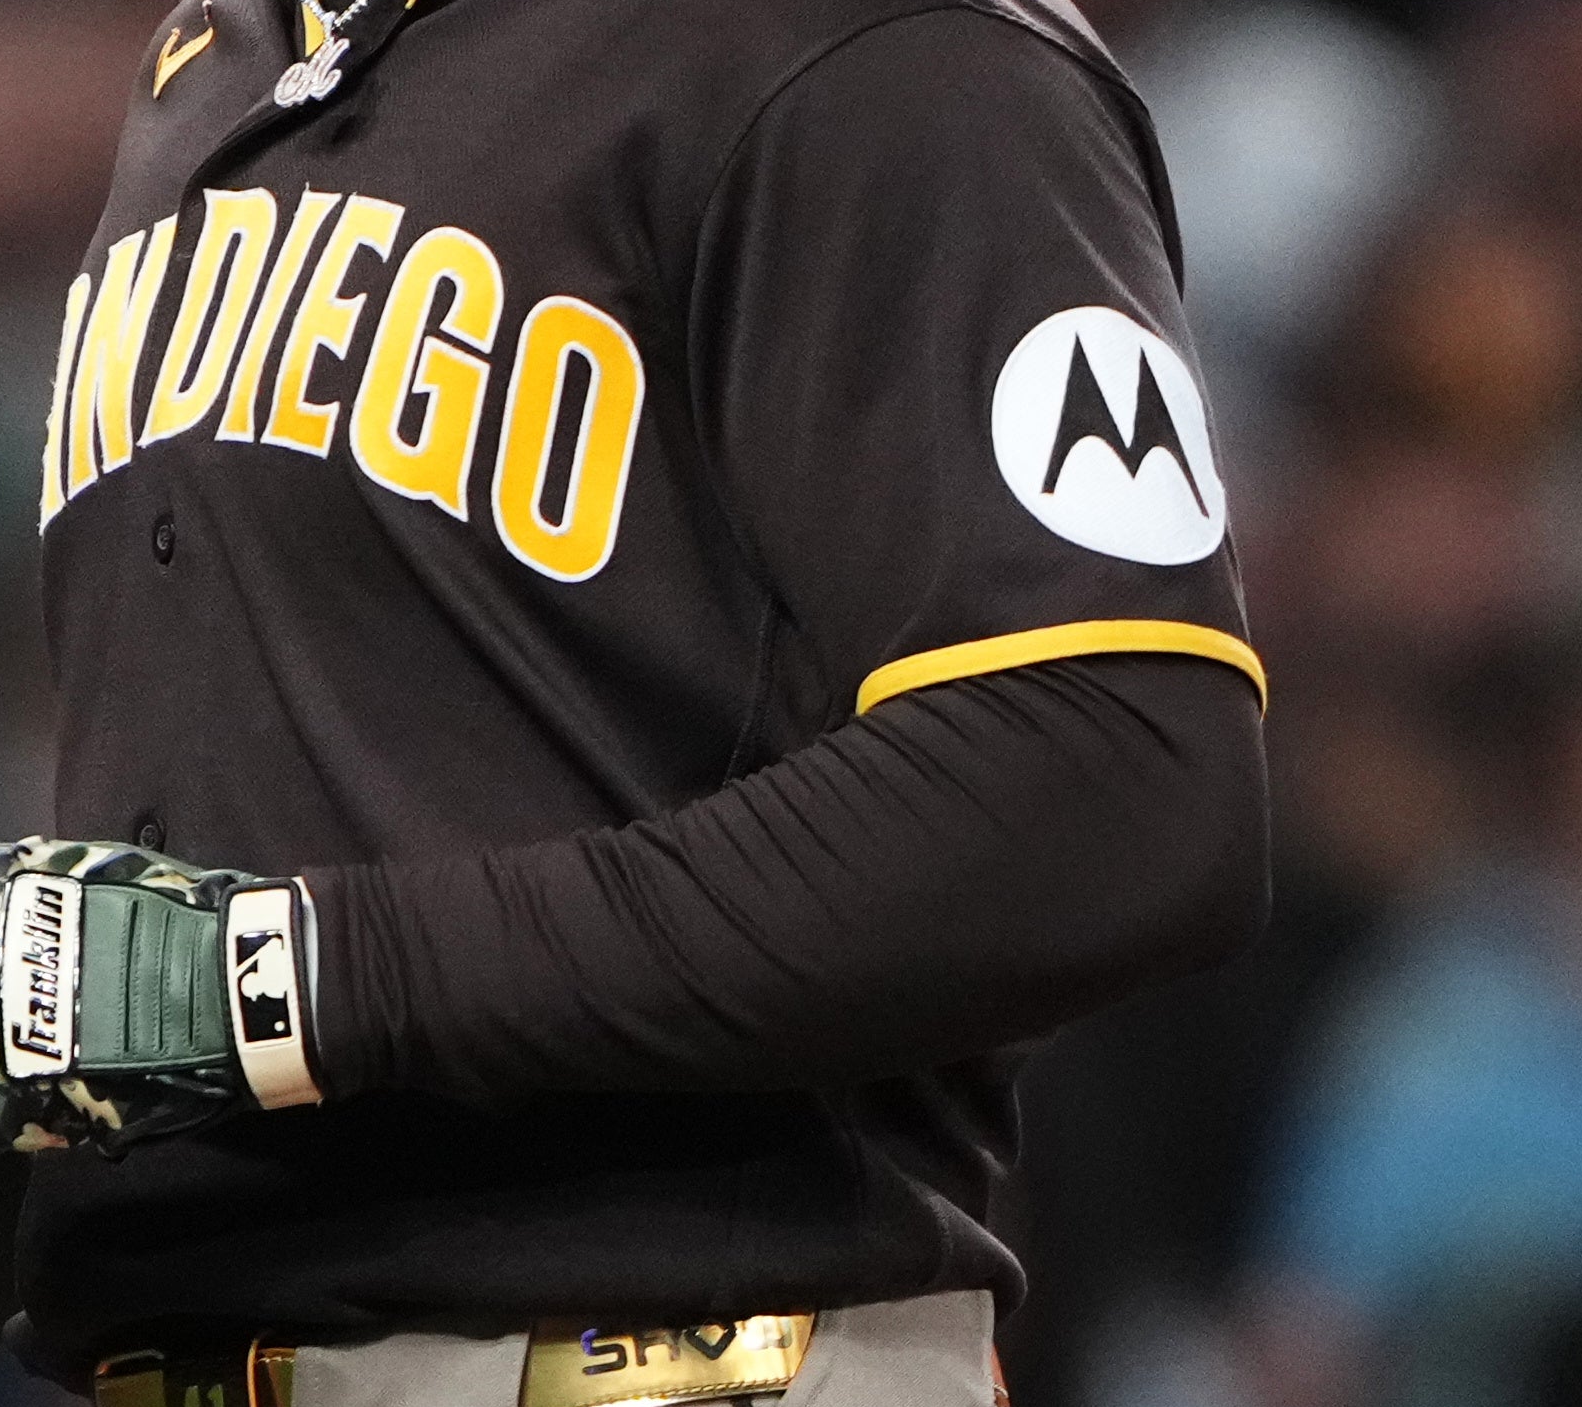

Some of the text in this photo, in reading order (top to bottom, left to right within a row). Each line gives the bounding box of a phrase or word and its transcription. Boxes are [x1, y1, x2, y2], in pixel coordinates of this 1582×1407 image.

[39, 185, 647, 583] N DIEGO
[12, 885, 64, 1061] Franklin
